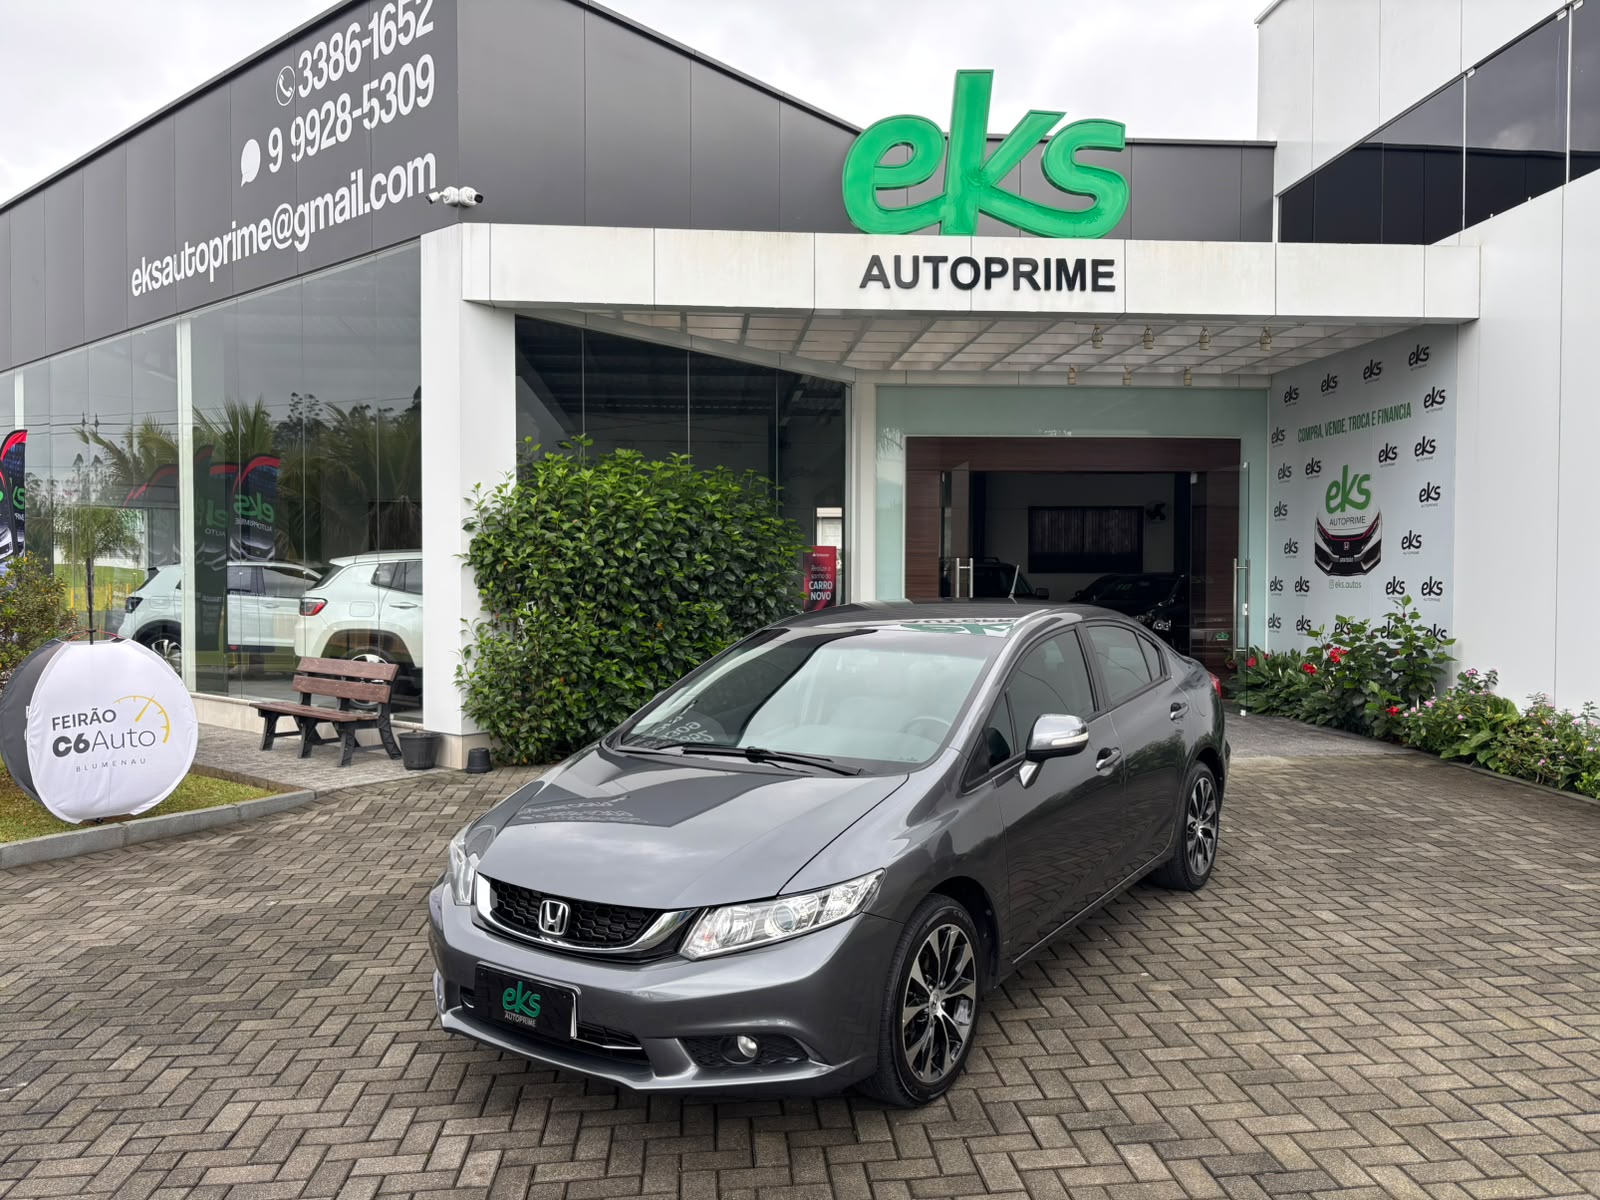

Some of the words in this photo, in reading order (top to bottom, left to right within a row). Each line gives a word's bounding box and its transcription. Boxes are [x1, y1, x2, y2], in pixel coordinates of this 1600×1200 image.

[297, 0, 434, 98] 3386-1652
[268, 127, 283, 173] 9
[290, 54, 435, 162] 9928-5309
[842, 69, 1130, 238] eks
[131, 152, 436, 296] eksautoprime@gmail.com
[859, 254, 1116, 292] AUTOPRIME
[1407, 344, 1429, 366] eks
[1363, 359, 1382, 380] eks
[1321, 373, 1338, 392] eks
[1284, 385, 1299, 403] eks
[1423, 386, 1446, 408] eks
[1298, 424, 1323, 443] COMPRA,
[1325, 418, 1347, 437] VENDE,
[1349, 412, 1370, 431] TROCA
[1371, 411, 1376, 426] E
[1378, 402, 1412, 424] FINANCIA
[1271, 427, 1286, 444] eks
[1378, 443, 1398, 463] eks
[1414, 436, 1436, 457] eks
[1278, 463, 1292, 480] eks
[1305, 457, 1322, 476] eks
[1325, 464, 1371, 514] eks
[1419, 482, 1441, 503] eks
[1274, 501, 1288, 518] eks
[1329, 515, 1366, 527] AUTOPRIME
[1284, 538, 1298, 555] eks
[1401, 530, 1422, 550] eks
[809, 581, 833, 590] CARRO
[1270, 576, 1283, 592] eks
[1294, 576, 1310, 593] eks
[1385, 576, 1405, 595] eks
[1421, 576, 1443, 596] eks
[810, 592, 832, 601] NOVO
[1268, 613, 1281, 629] eks
[1296, 615, 1311, 632] eks
[52, 708, 117, 731] FEIRÃO
[76, 758, 147, 772] BLUMENAU
[502, 981, 541, 1018] eks
[504, 1010, 537, 1027] AUTOPRIME
